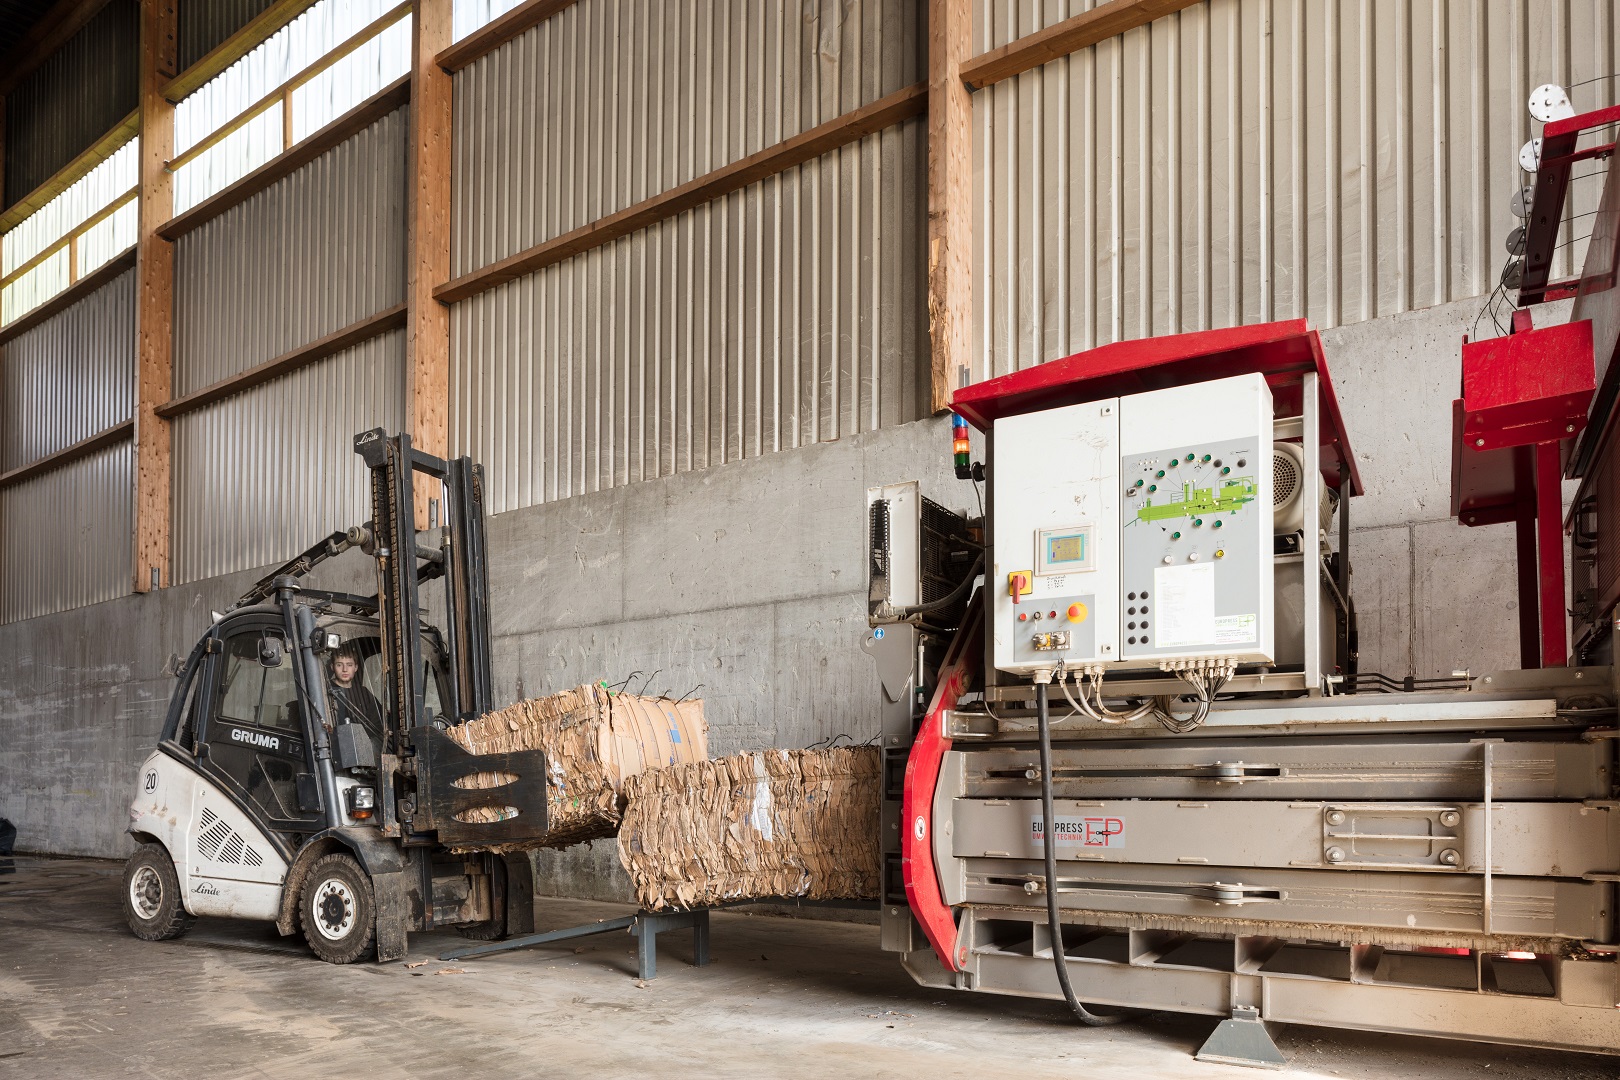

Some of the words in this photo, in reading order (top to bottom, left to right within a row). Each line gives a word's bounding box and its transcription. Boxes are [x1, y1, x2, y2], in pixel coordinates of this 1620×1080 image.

[356, 432, 379, 445] Linde
[231, 729, 279, 750] GRUMA
[145, 773, 156, 790] 20
[1032, 823, 1082, 833] EUPRESS
[191, 882, 220, 896] Linde
